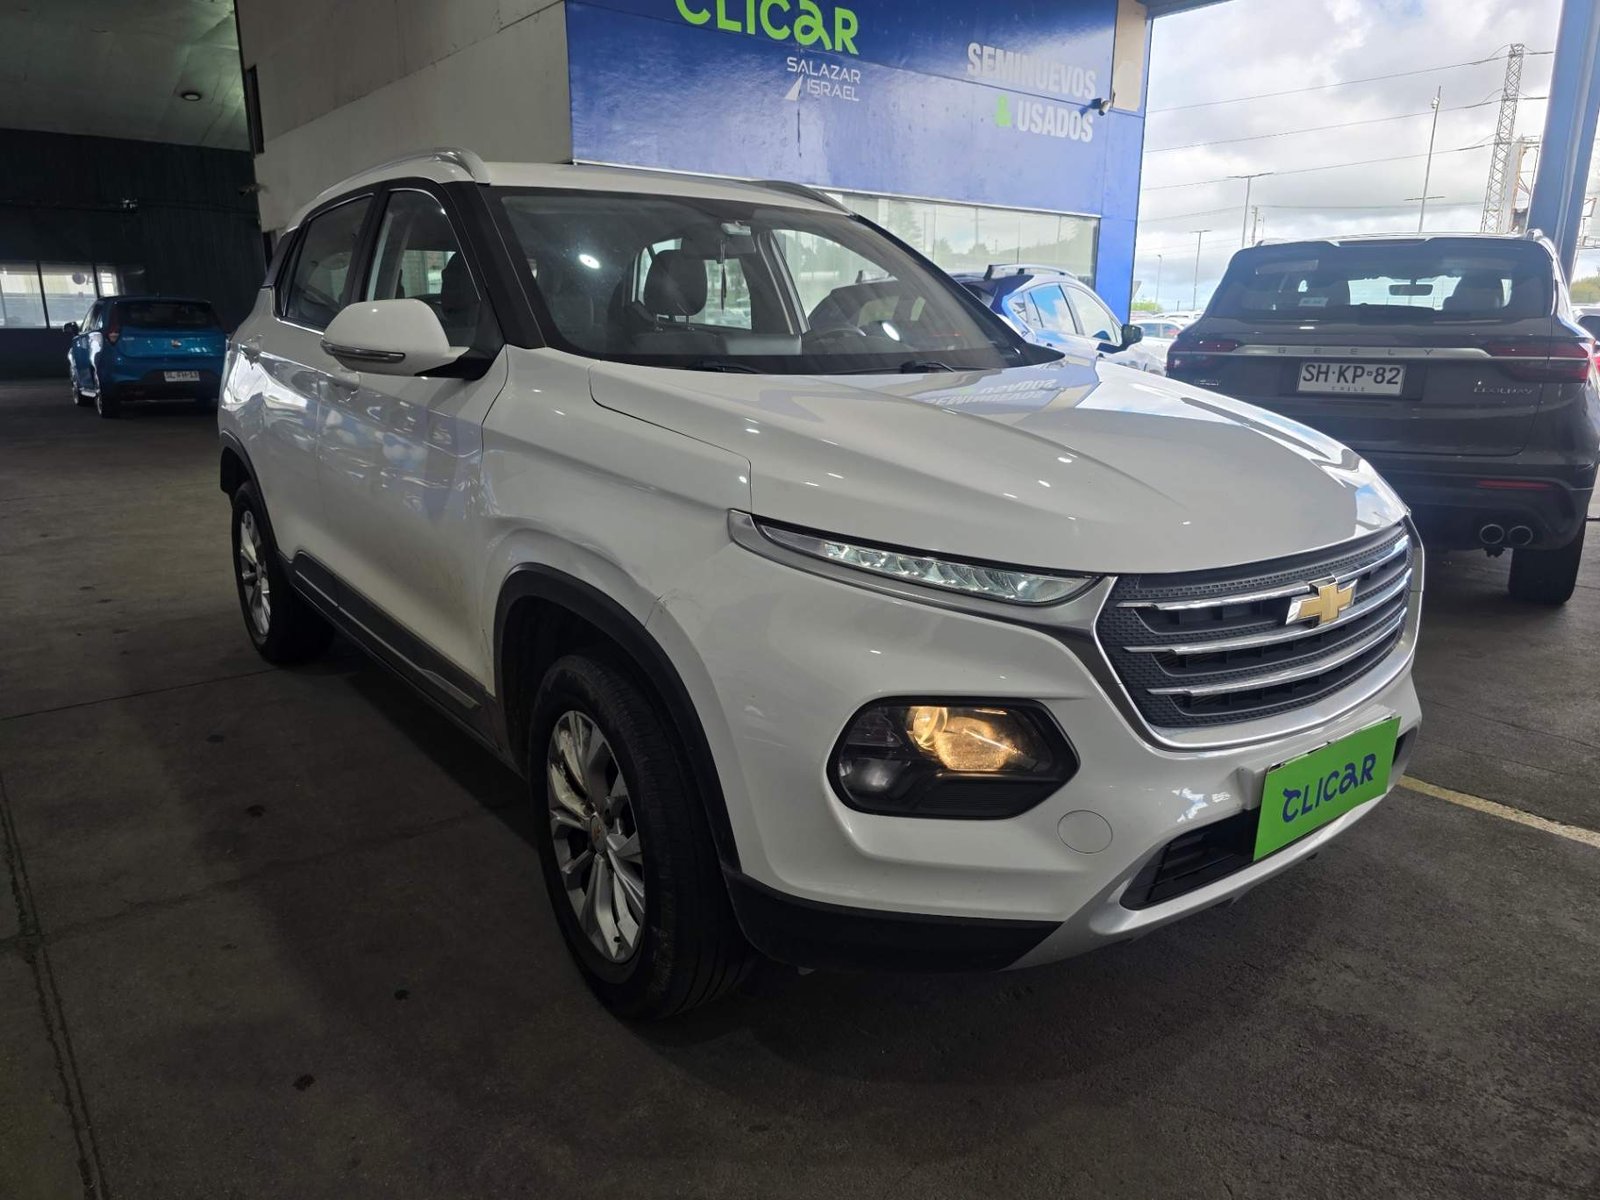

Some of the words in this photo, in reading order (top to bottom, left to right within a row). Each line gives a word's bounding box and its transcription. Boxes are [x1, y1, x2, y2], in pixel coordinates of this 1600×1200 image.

[786, 56, 861, 85] SALAZAR
[967, 42, 1097, 100] SEMINUEVOS
[807, 80, 860, 102] ISRAEL
[1017, 100, 1094, 143] USADOS
[1278, 347, 1434, 356] GEELY
